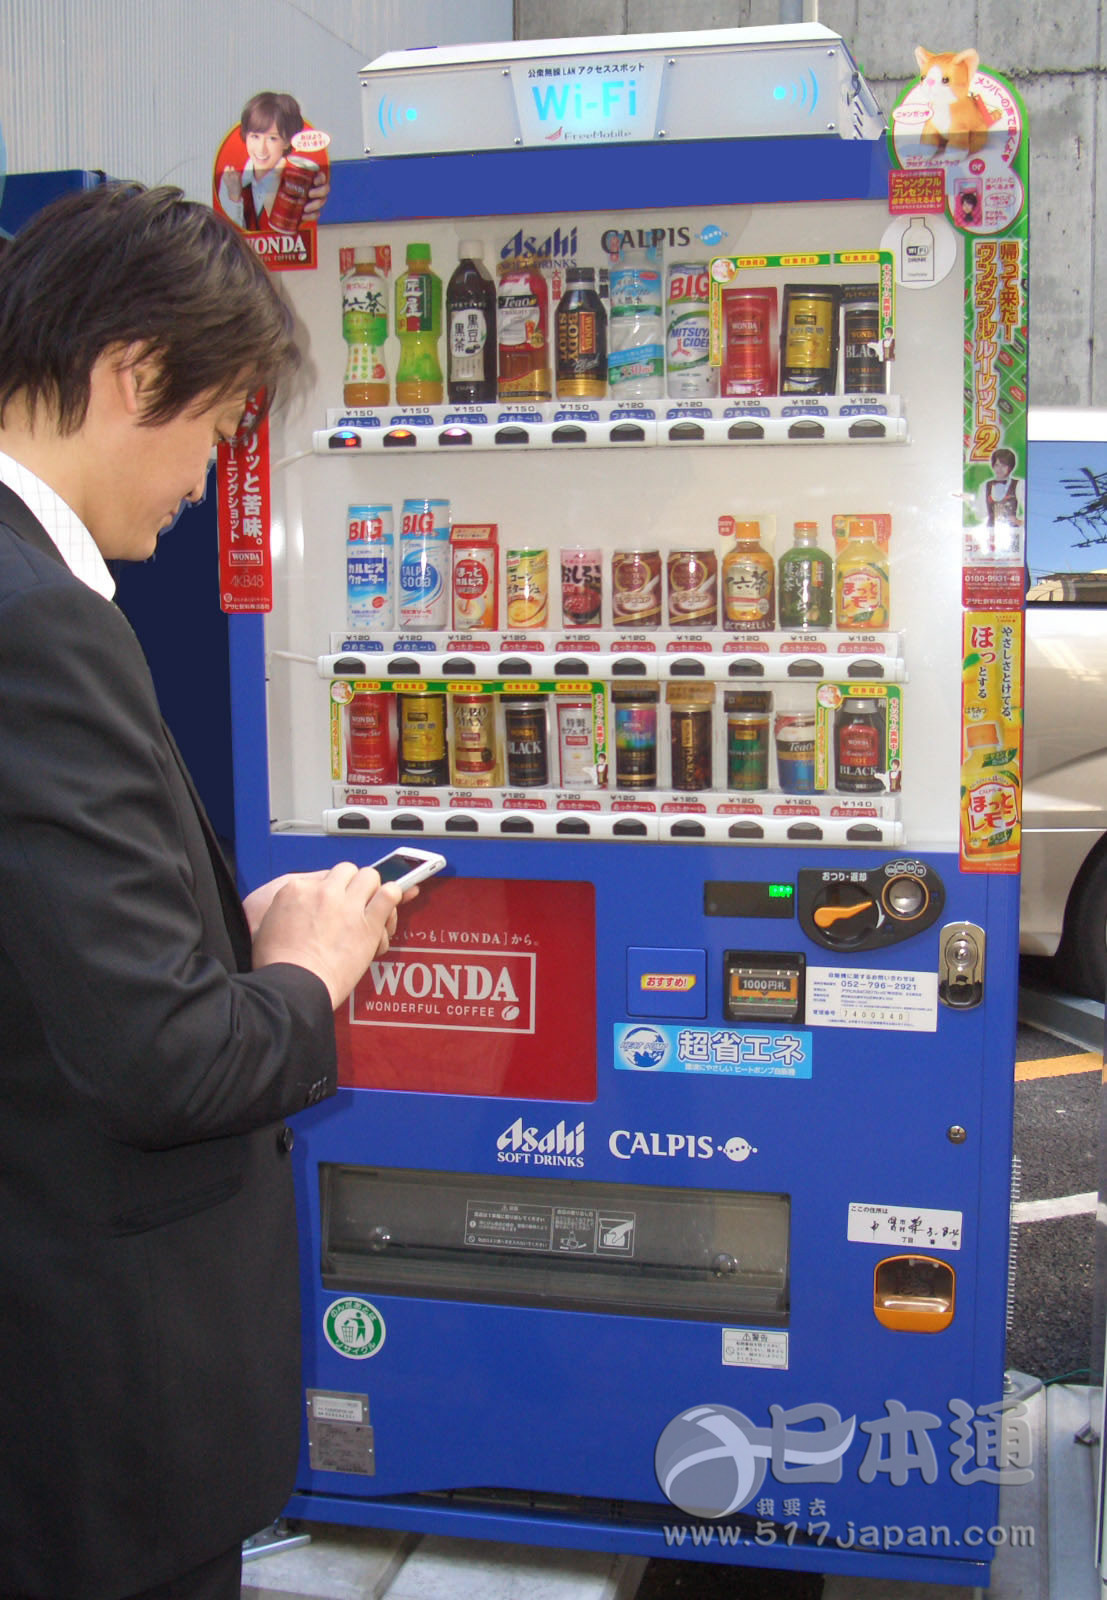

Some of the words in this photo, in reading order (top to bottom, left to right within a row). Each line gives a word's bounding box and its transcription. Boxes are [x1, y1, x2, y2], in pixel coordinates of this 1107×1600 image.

[563, 67, 575, 76] LAN
[578, 63, 644, 75] アクセススポット
[532, 80, 636, 120] Wi-Fi
[972, 163, 982, 171] or
[500, 226, 577, 259] Asahi
[601, 227, 690, 254] CALPIS
[669, 272, 710, 299] BIG
[467, 314, 478, 342] 黒豆
[731, 321, 758, 330] WONDA
[846, 345, 879, 358] BLAC
[349, 518, 384, 541] BIG
[402, 512, 434, 536] BIG
[232, 553, 260, 561] WONDA
[349, 563, 384, 574] カルピス
[458, 567, 482, 578] ほっと
[349, 575, 384, 585] ウォーター
[973, 792, 1014, 814] ほっと
[971, 811, 1017, 832] レモン
[821, 872, 867, 882] おつり・返却
[369, 962, 519, 1002] WONDA
[645, 977, 688, 988] おすすめ!
[742, 980, 787, 991] 1000円札
[841, 980, 917, 990] 052-796-2921
[366, 1001, 440, 1015] WONDERFUL
[446, 1005, 495, 1017] COFFEE
[678, 1030, 804, 1065] 超省エネ
[496, 1117, 584, 1155] Asahi
[609, 1130, 713, 1159] CALPIS
[497, 1152, 530, 1163] SOFT
[534, 1154, 584, 1168] DRINKS
[334, 1339, 376, 1355] リサイクル
